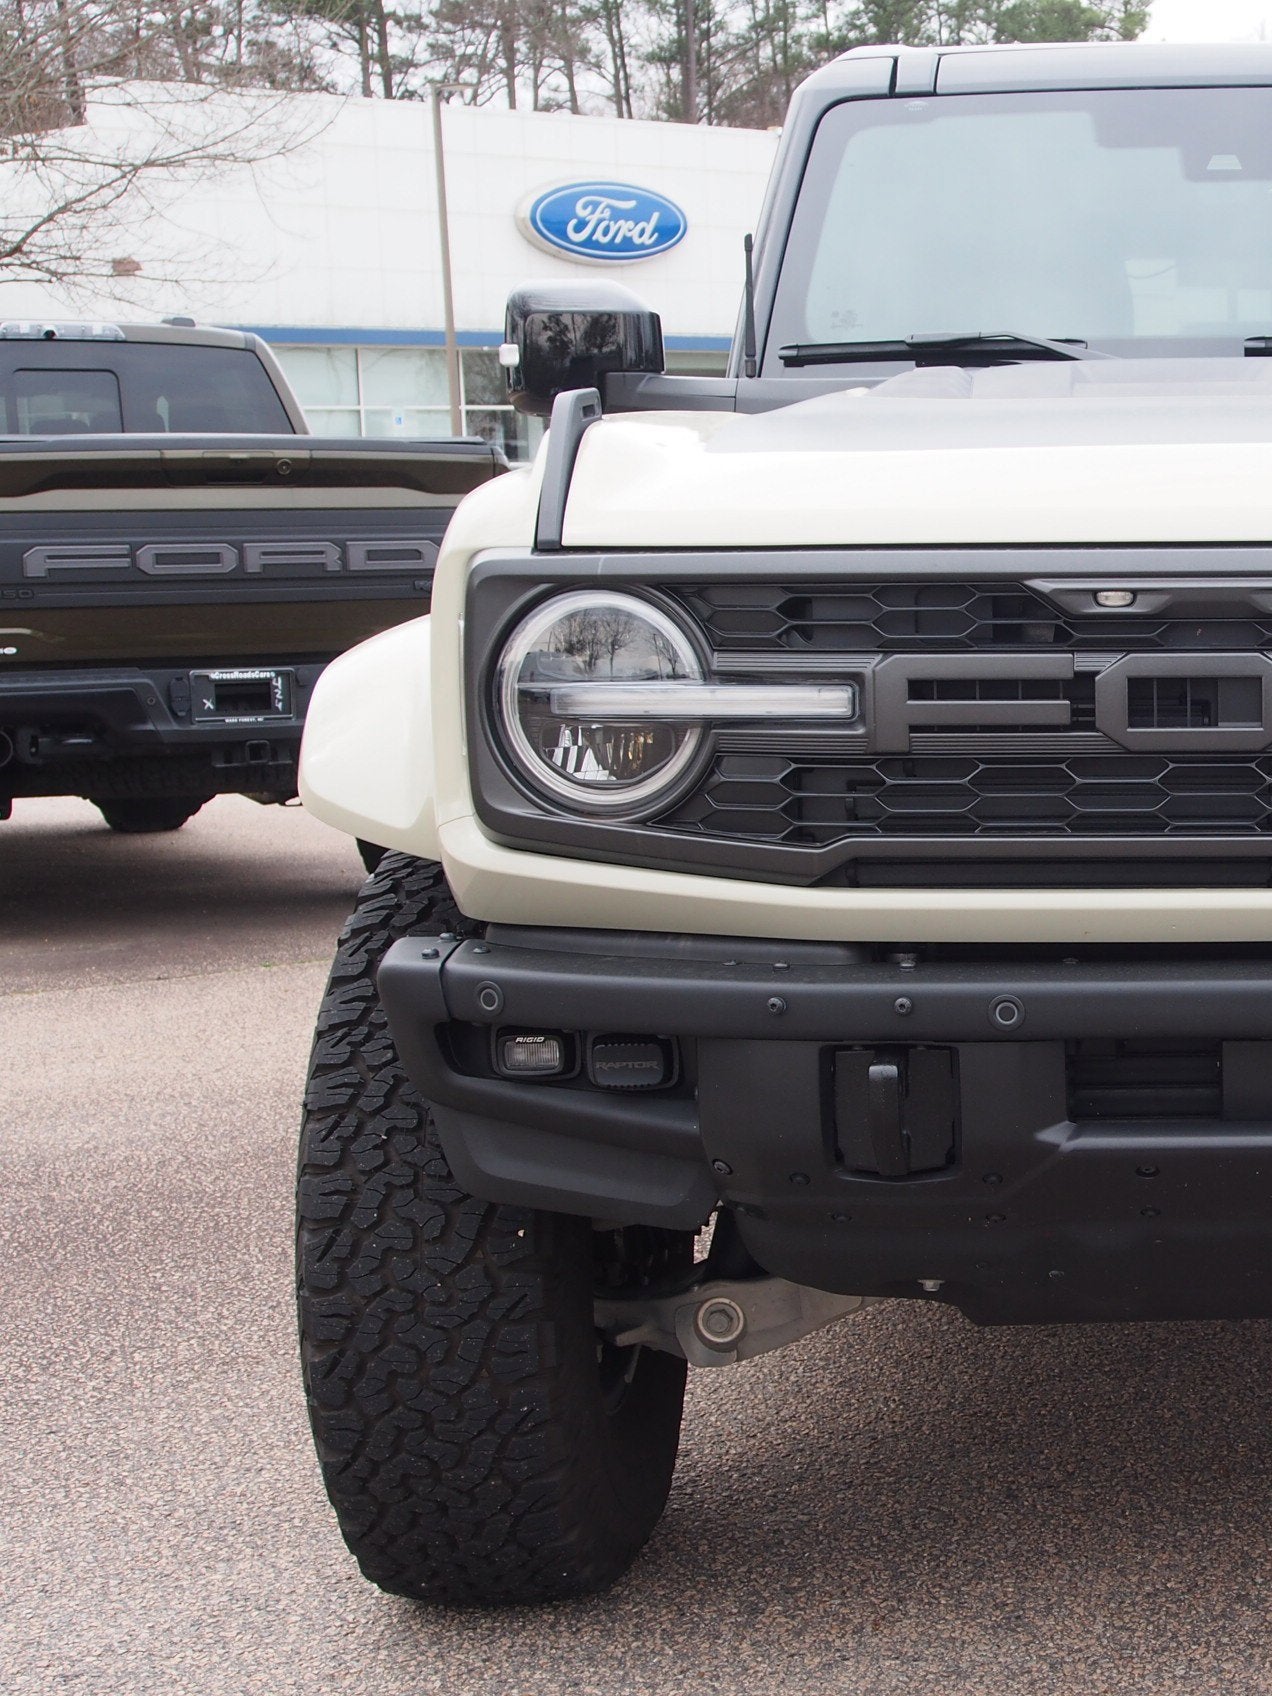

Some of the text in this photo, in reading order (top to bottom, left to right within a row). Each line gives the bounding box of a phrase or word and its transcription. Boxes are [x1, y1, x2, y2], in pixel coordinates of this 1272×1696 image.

[566, 195, 661, 245] Ford
[22, 541, 441, 578] FORD
[595, 1061, 661, 1071] RAPTOR
